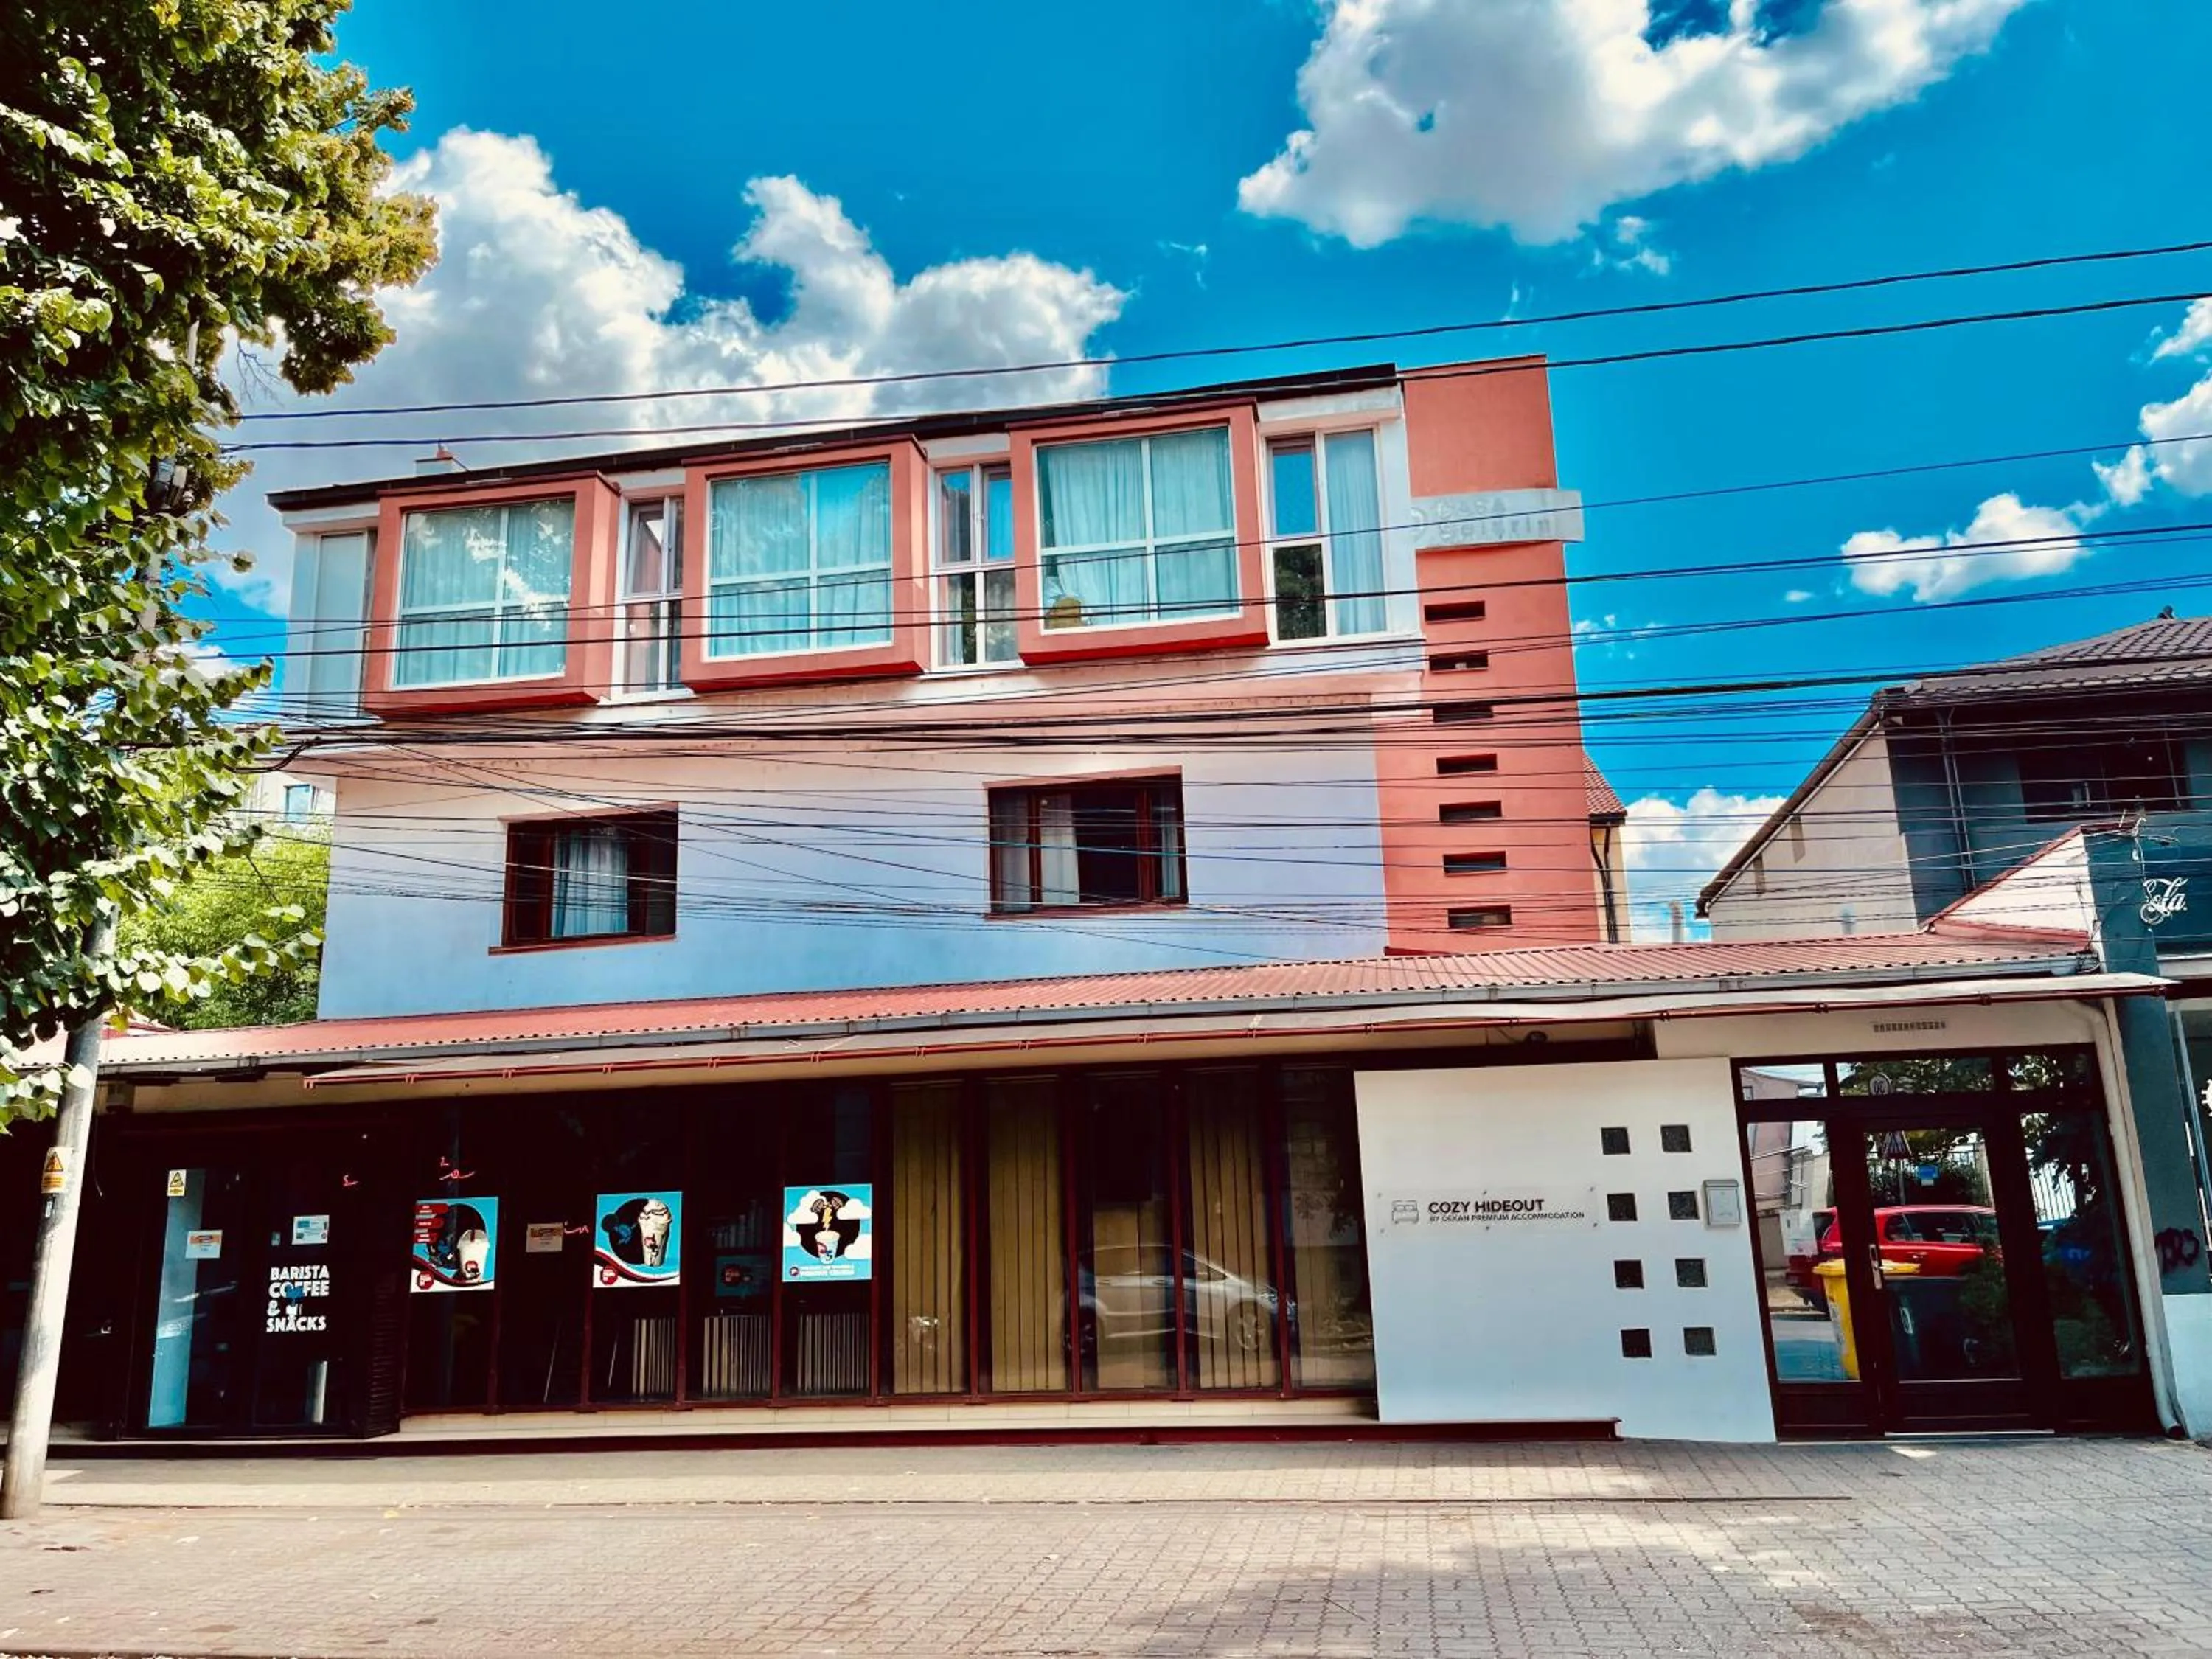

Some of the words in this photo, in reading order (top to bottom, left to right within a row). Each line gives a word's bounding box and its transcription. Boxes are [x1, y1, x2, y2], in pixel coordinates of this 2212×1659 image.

[1428, 1201, 1471, 1214] COZY
[1475, 1199, 1545, 1212] HIDEOUT
[270, 1265, 330, 1281] BARISTA
[267, 1300, 281, 1316] &
[266, 1315, 327, 1333] SNACKS
